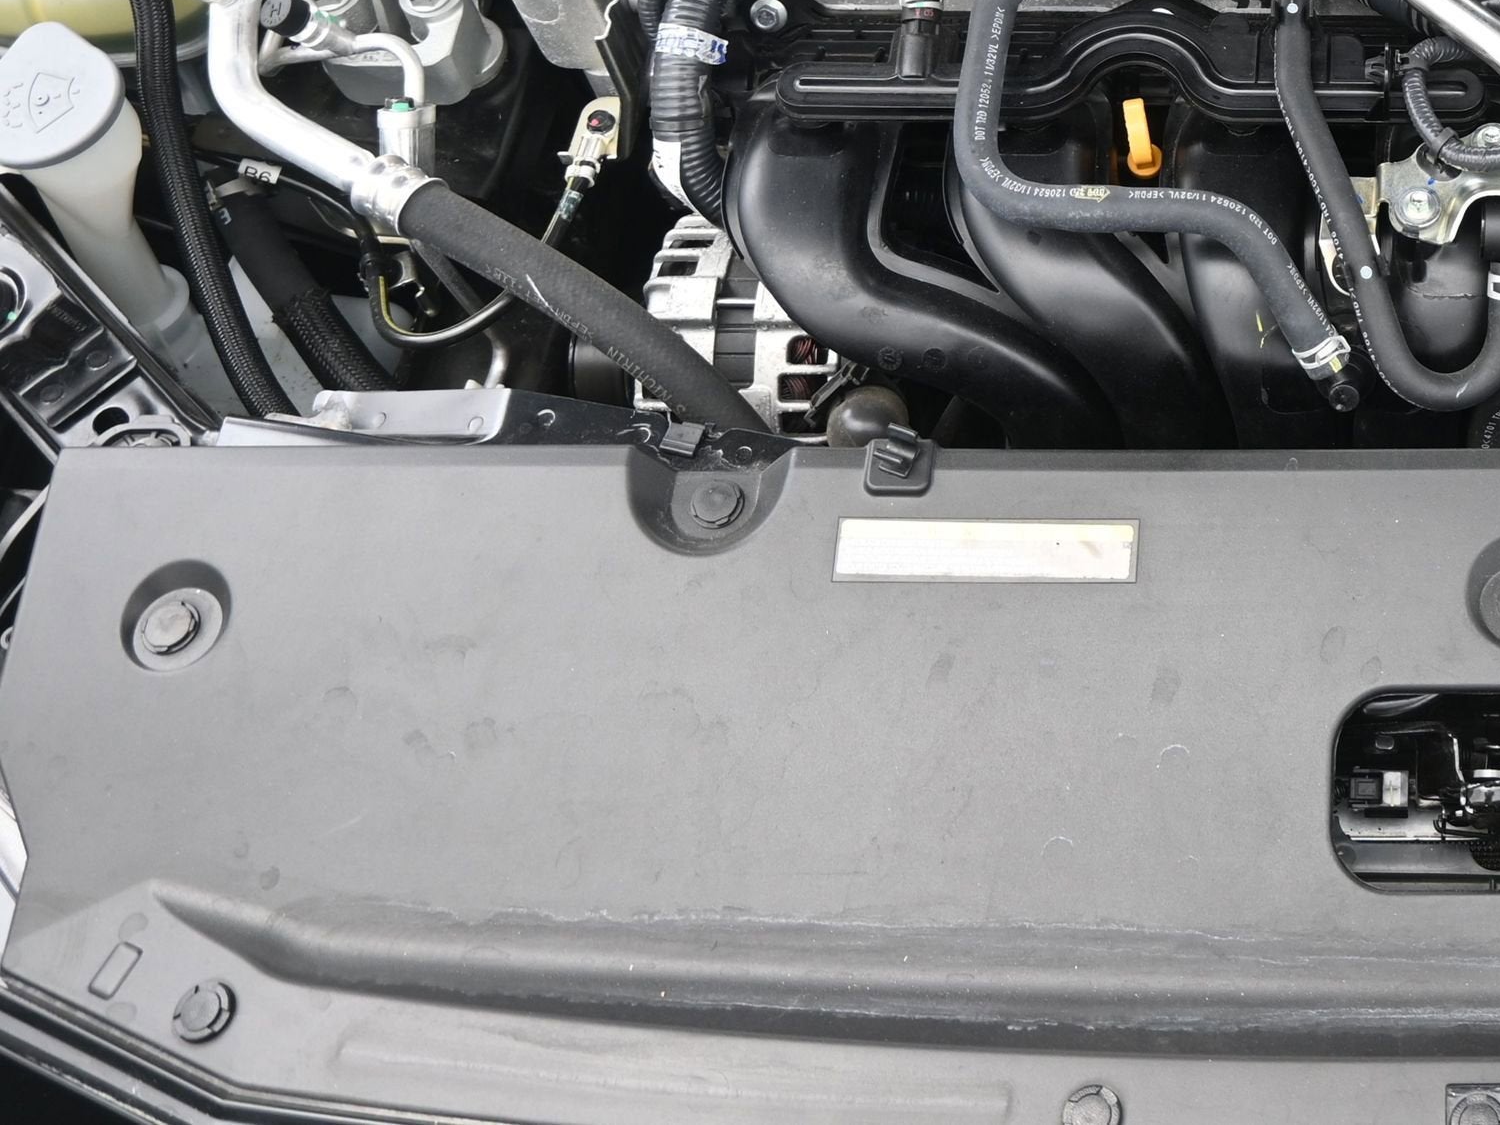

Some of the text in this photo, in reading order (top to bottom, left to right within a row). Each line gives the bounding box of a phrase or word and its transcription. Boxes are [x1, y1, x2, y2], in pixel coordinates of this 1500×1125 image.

[975, 125, 986, 141] DOT
[984, 79, 993, 109] 12052
[1210, 195, 1247, 216] 120524
[1263, 228, 1278, 245] DOT
[606, 346, 672, 402] NICHIRIN
